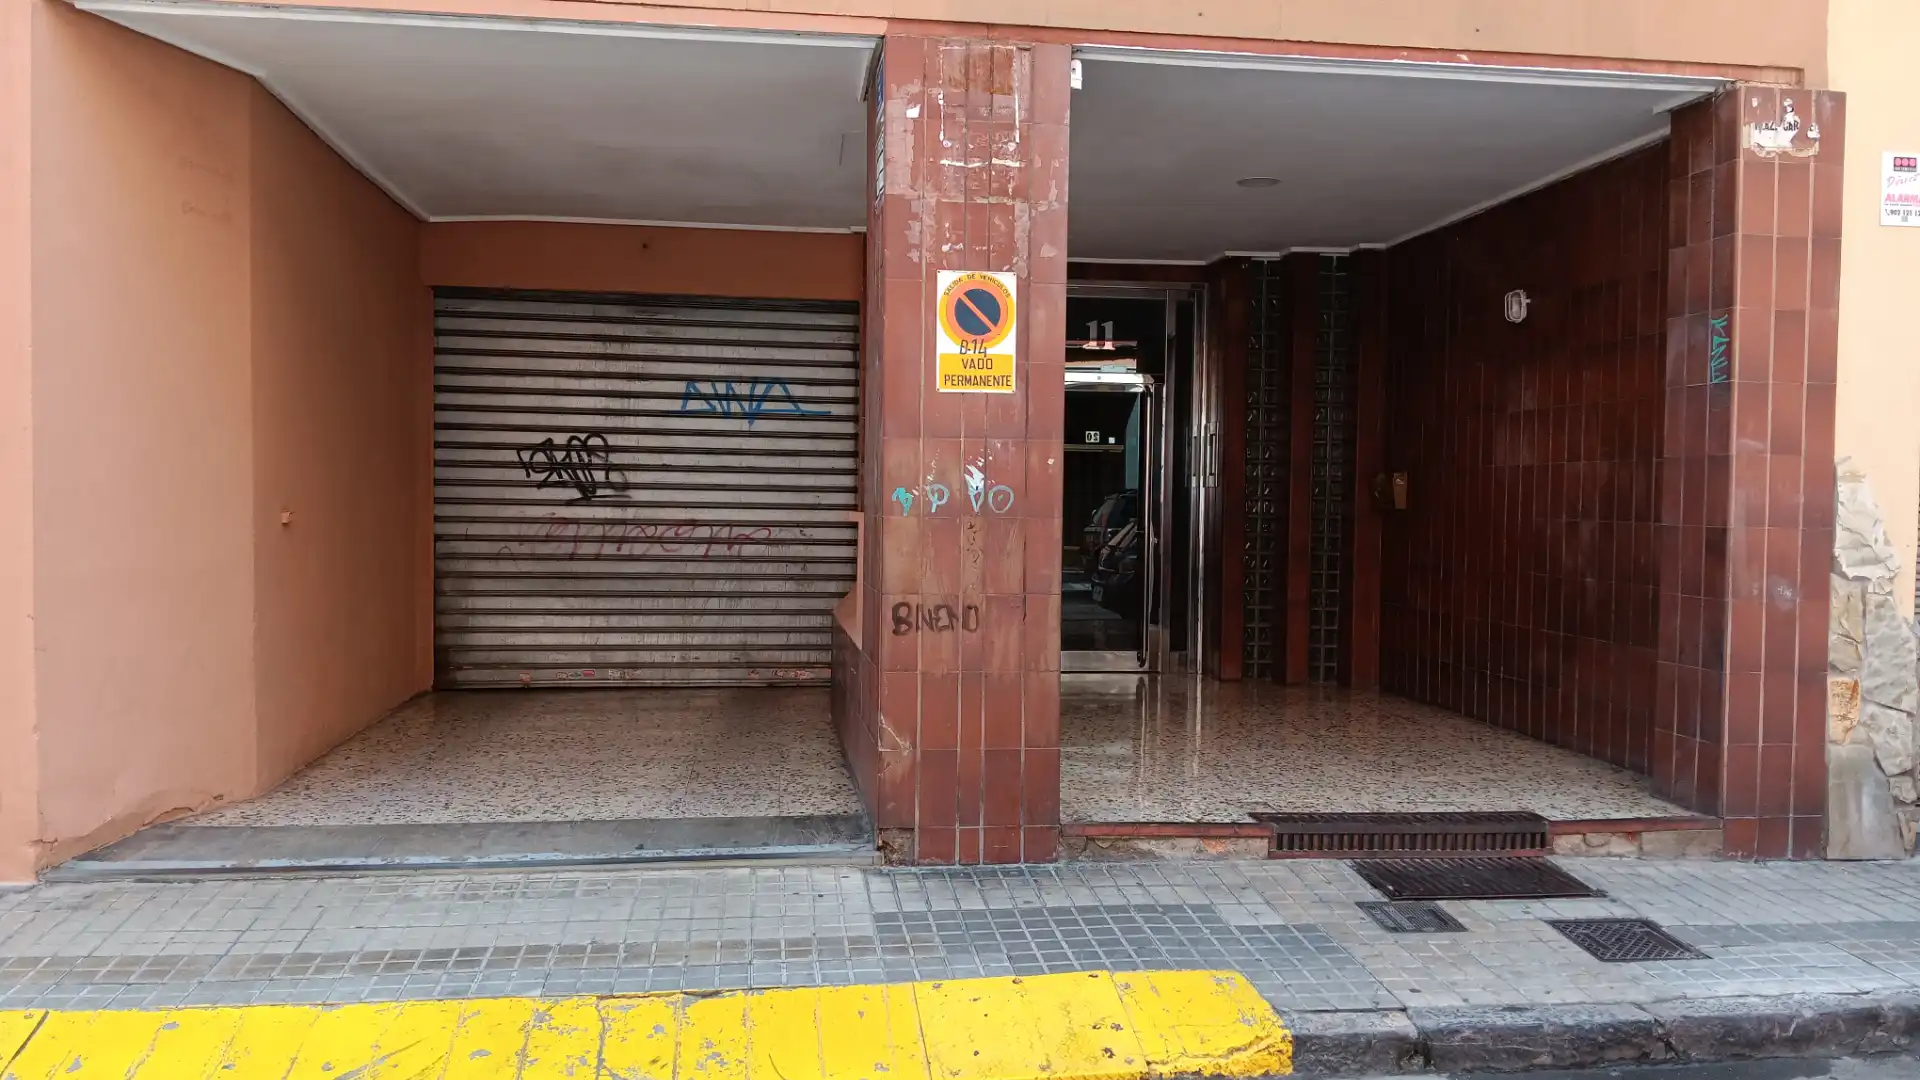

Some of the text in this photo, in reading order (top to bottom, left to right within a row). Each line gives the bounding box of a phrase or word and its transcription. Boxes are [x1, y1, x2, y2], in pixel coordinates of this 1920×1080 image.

[1885, 193, 1920, 203] ALARM
[943, 277, 964, 297] SALIDA
[1083, 320, 1116, 350] 11
[961, 358, 993, 370] VADO
[944, 374, 1012, 387] PERMANENTE
